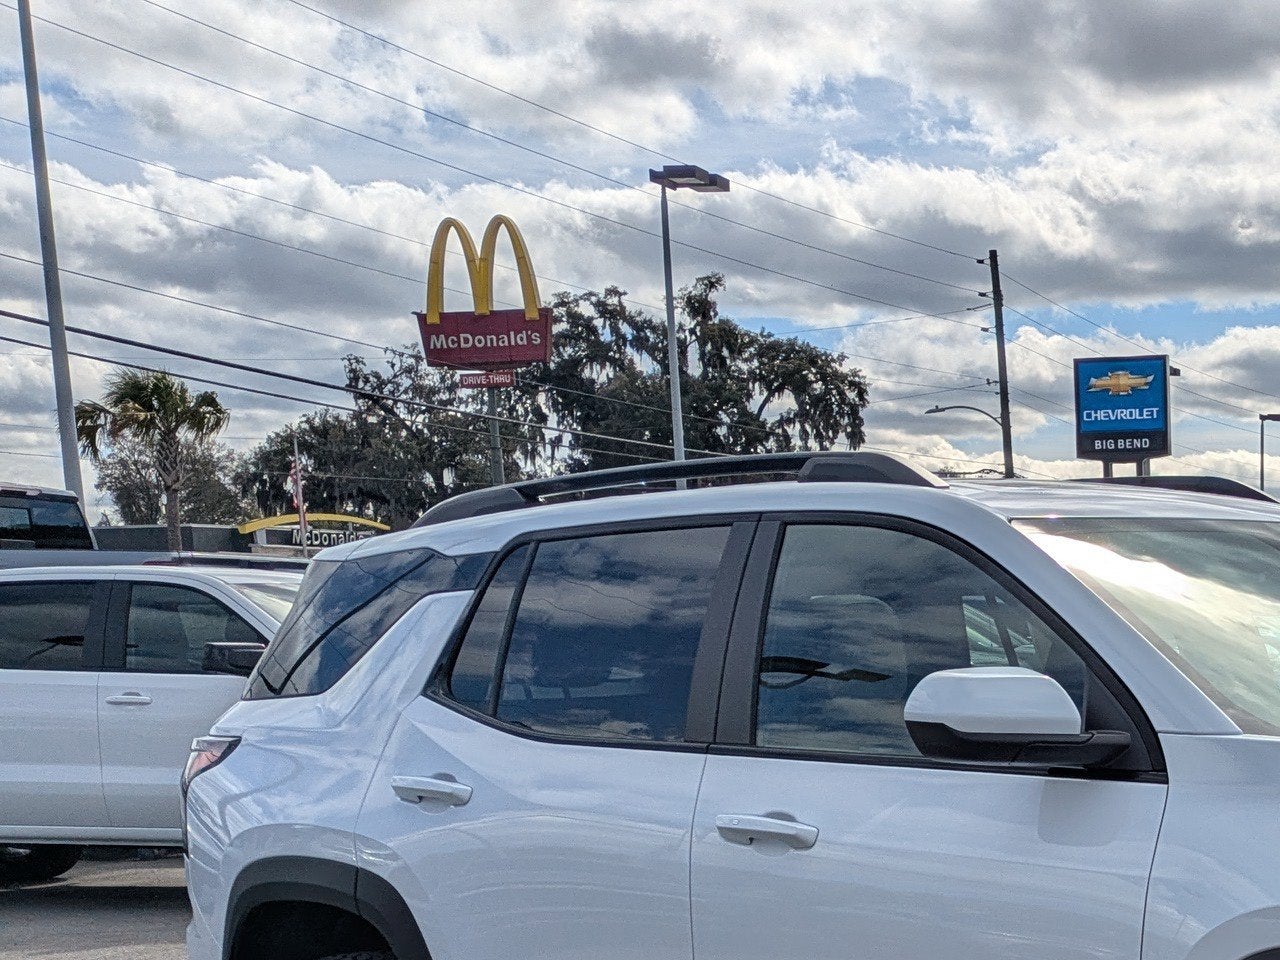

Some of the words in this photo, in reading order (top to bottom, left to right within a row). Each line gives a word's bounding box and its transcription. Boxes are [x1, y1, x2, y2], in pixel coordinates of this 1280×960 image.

[430, 331, 541, 349] McDonald's
[462, 374, 511, 385] DRIVE-THRU
[1083, 408, 1160, 421] CHEVROLET
[1094, 440, 1115, 450] BIG
[1117, 438, 1150, 449] BEND
[292, 529, 365, 546] McDonald
